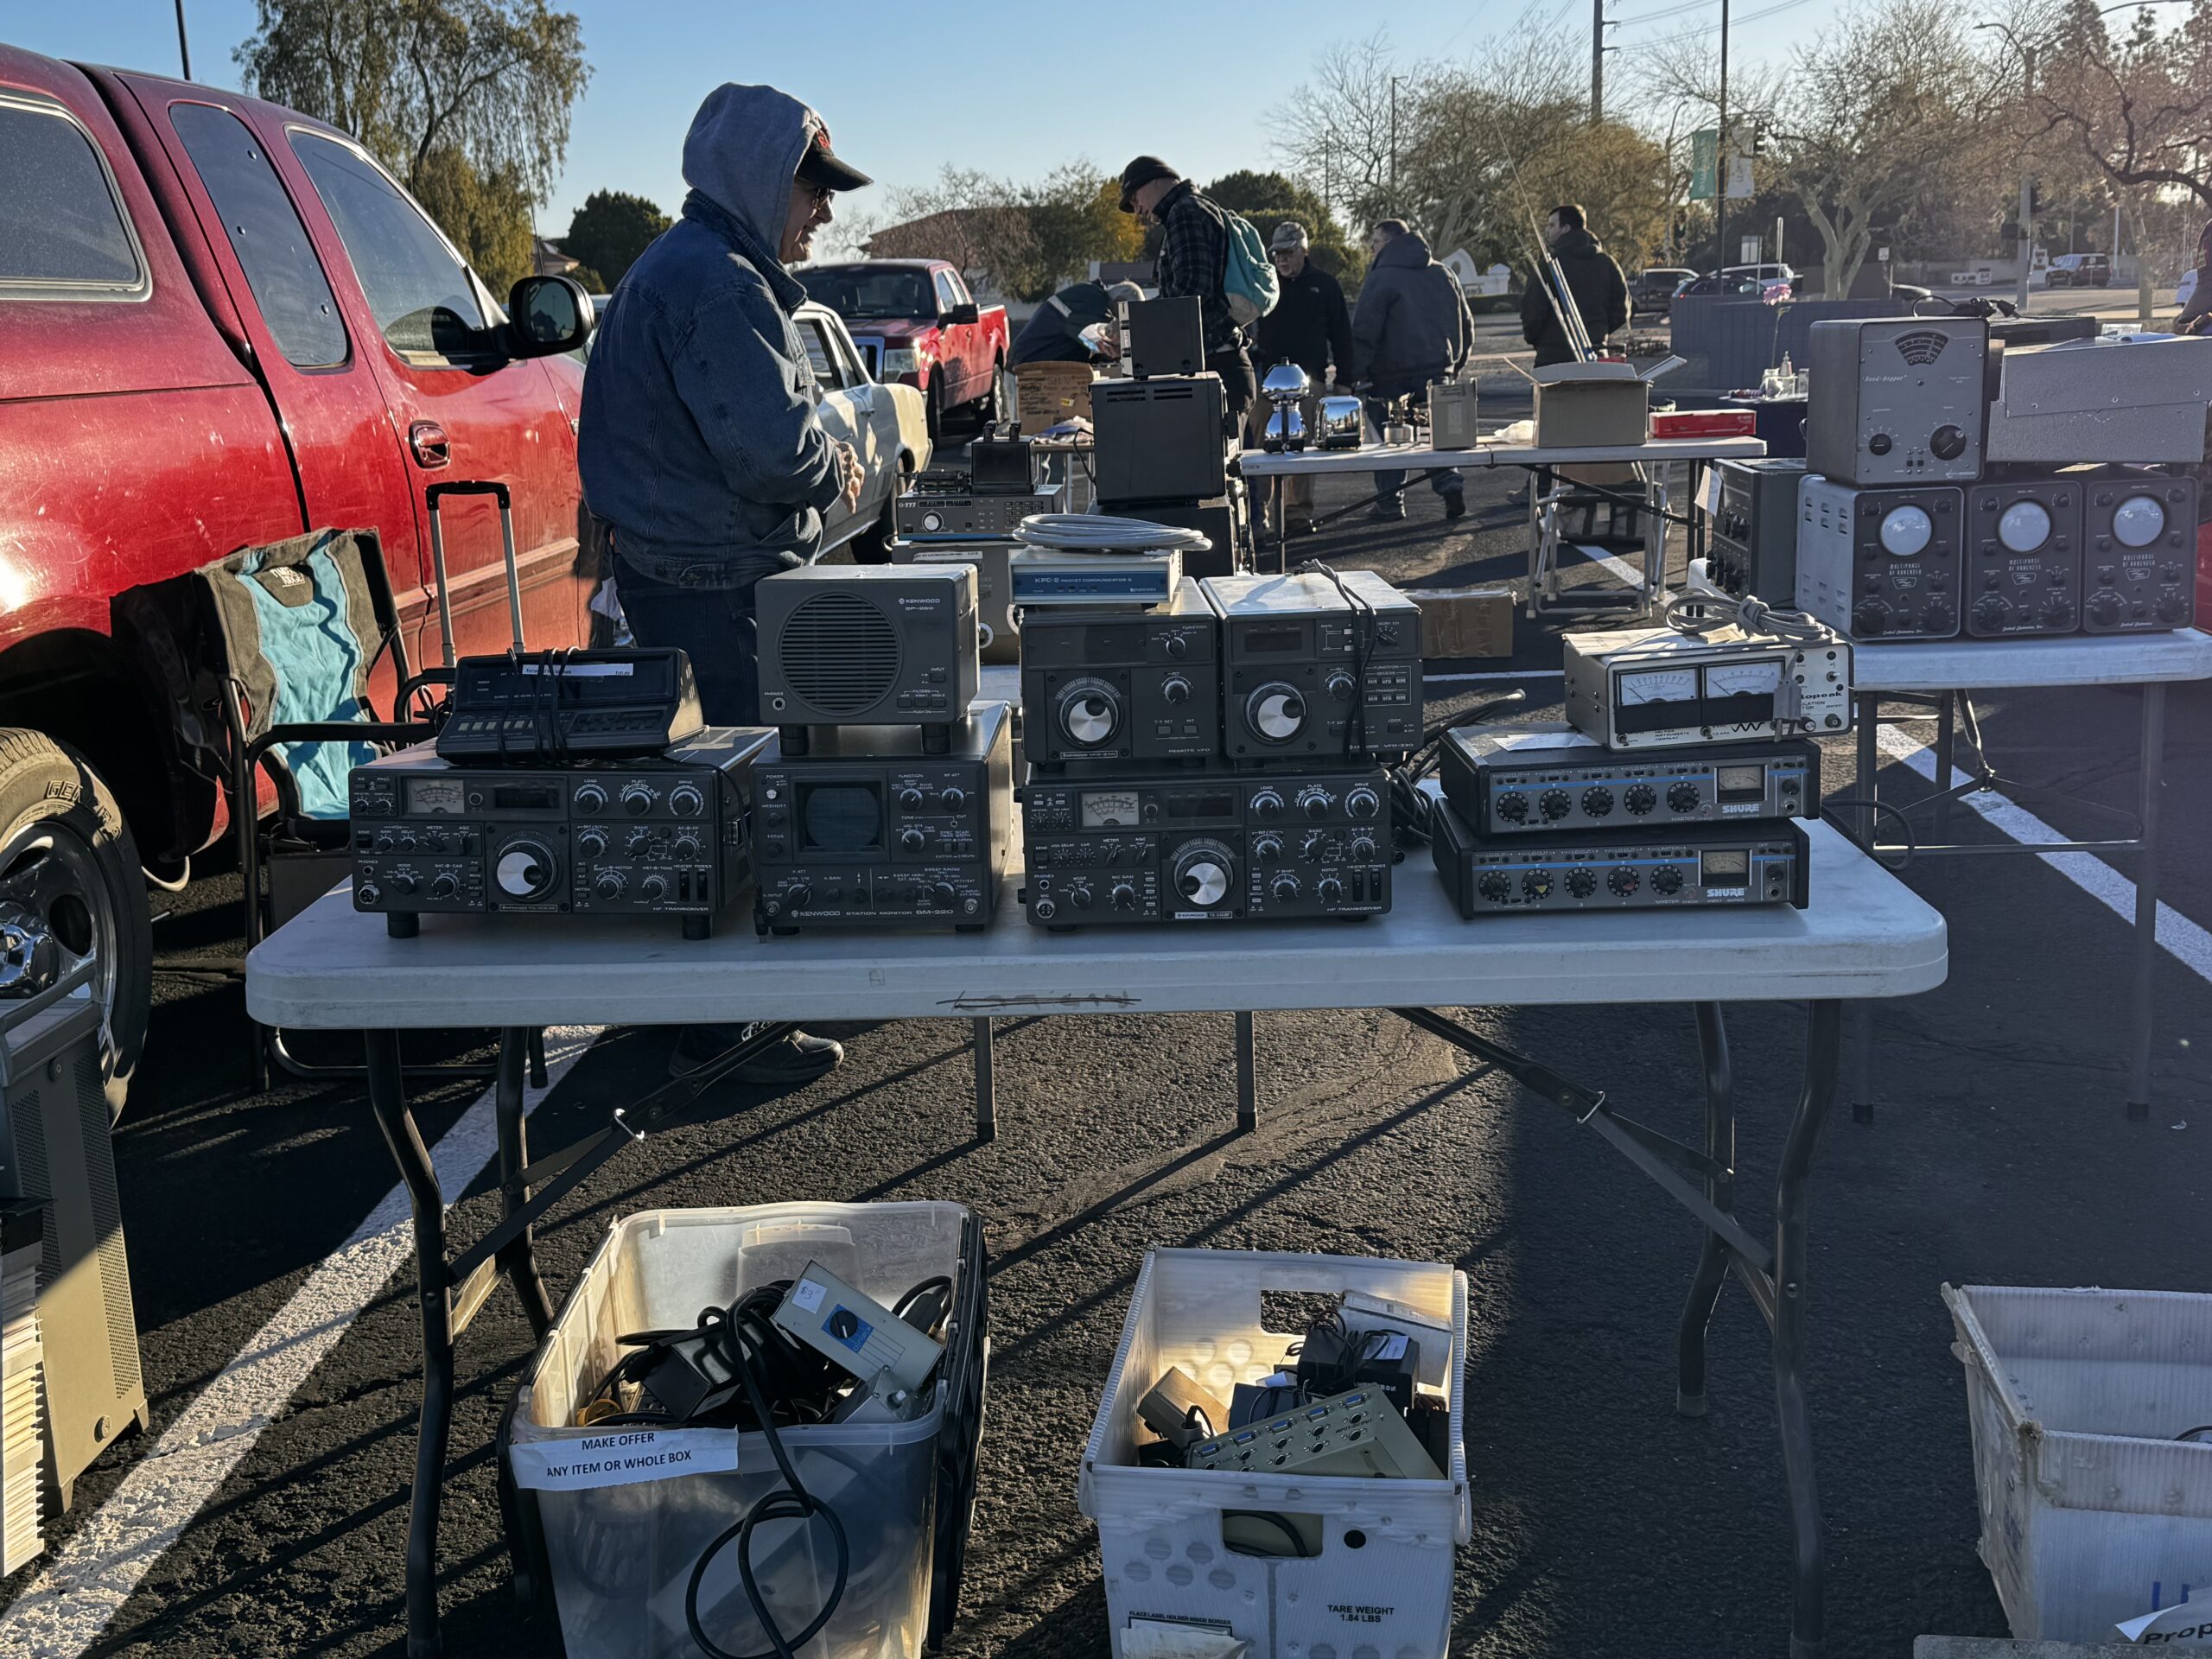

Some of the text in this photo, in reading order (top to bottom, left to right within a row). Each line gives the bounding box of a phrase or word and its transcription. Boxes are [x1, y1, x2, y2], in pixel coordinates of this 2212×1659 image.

[1722, 804, 1759, 813] SHURE
[1707, 888, 1745, 897] SHURE
[582, 1433, 655, 1450] MAKE OFFER
[547, 1450, 691, 1478] ANY ITEM OR WHOLE BOX
[1327, 1605, 1395, 1616] TARE WEIGHT
